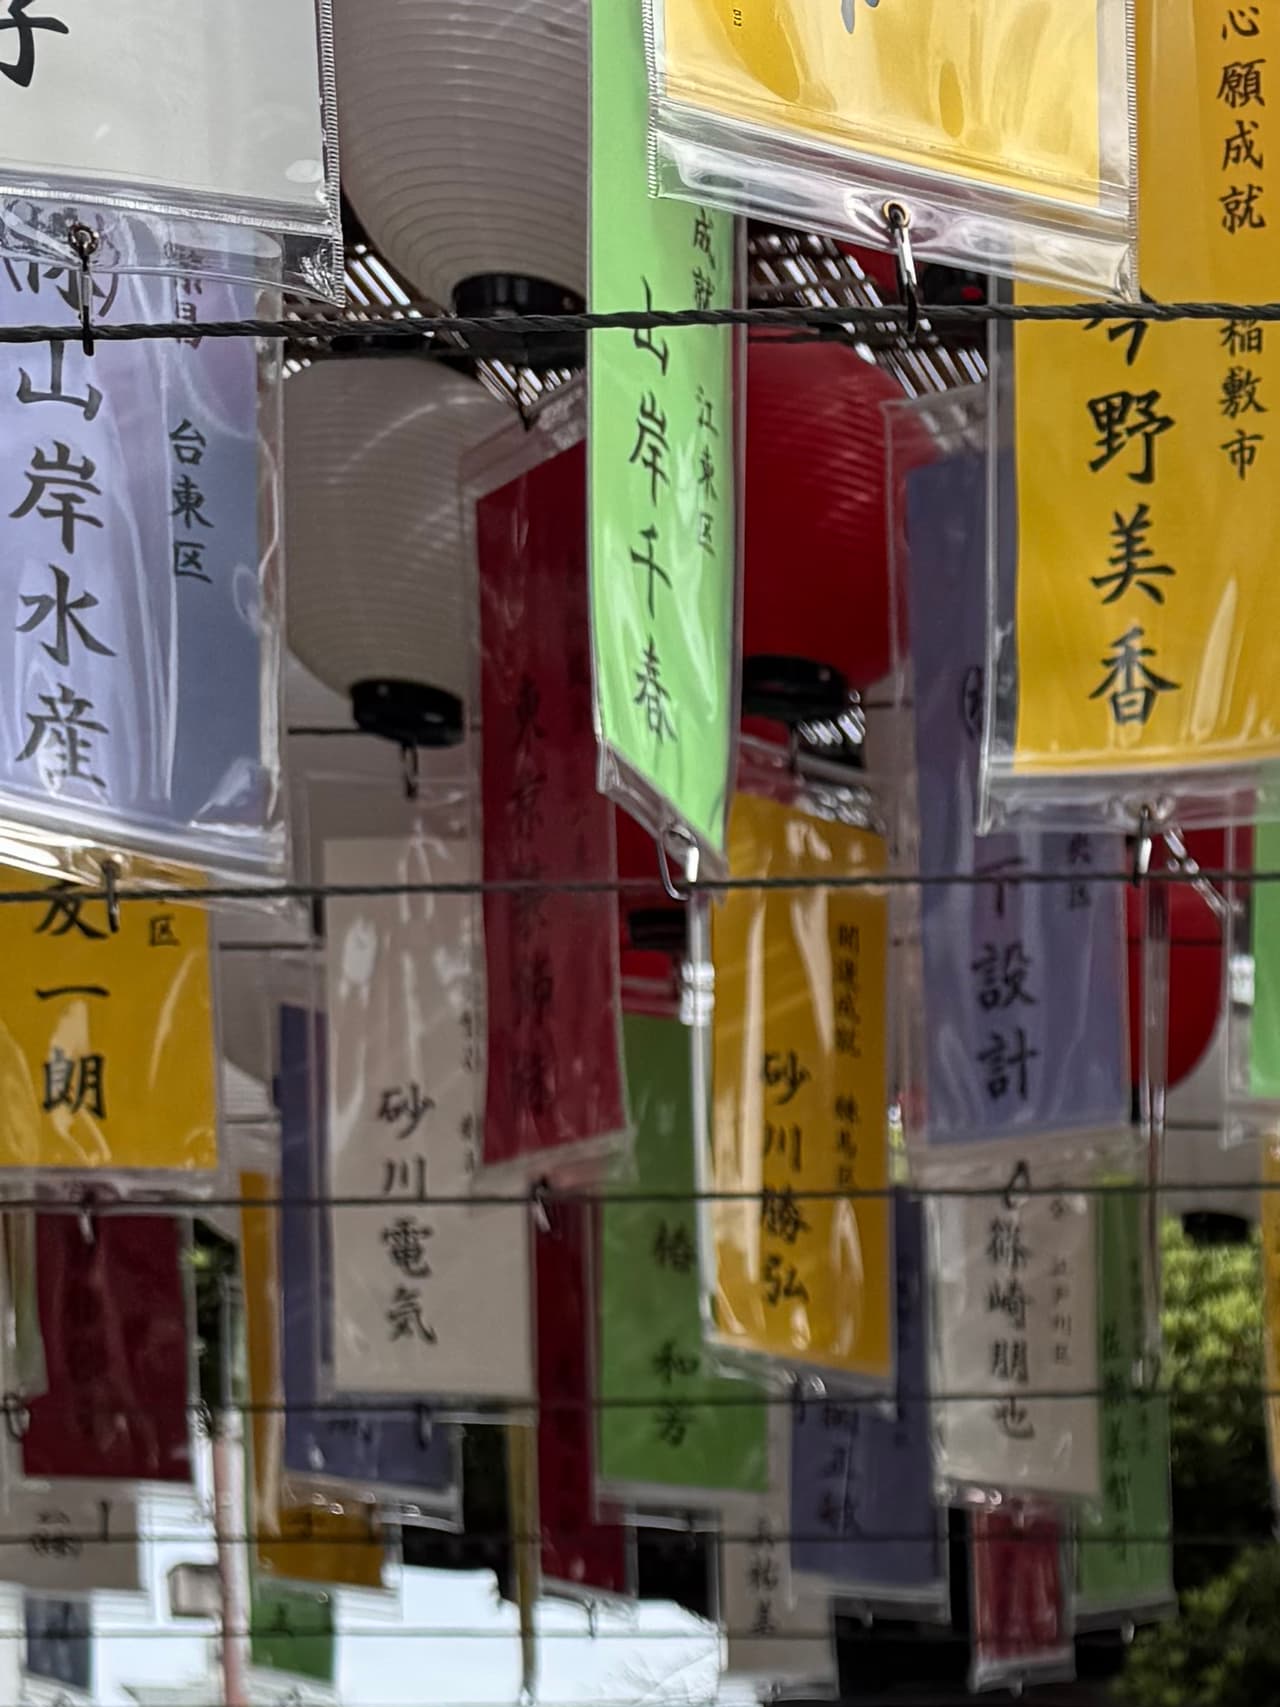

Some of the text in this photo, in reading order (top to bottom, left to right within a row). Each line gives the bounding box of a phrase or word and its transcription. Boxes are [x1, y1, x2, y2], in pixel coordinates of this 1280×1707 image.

[1217, 5, 1267, 234] 心願成就
[167, 417, 213, 586] 台東区
[628, 276, 678, 745] 山岸千春
[378, 1082, 437, 1346] 砂川電気
